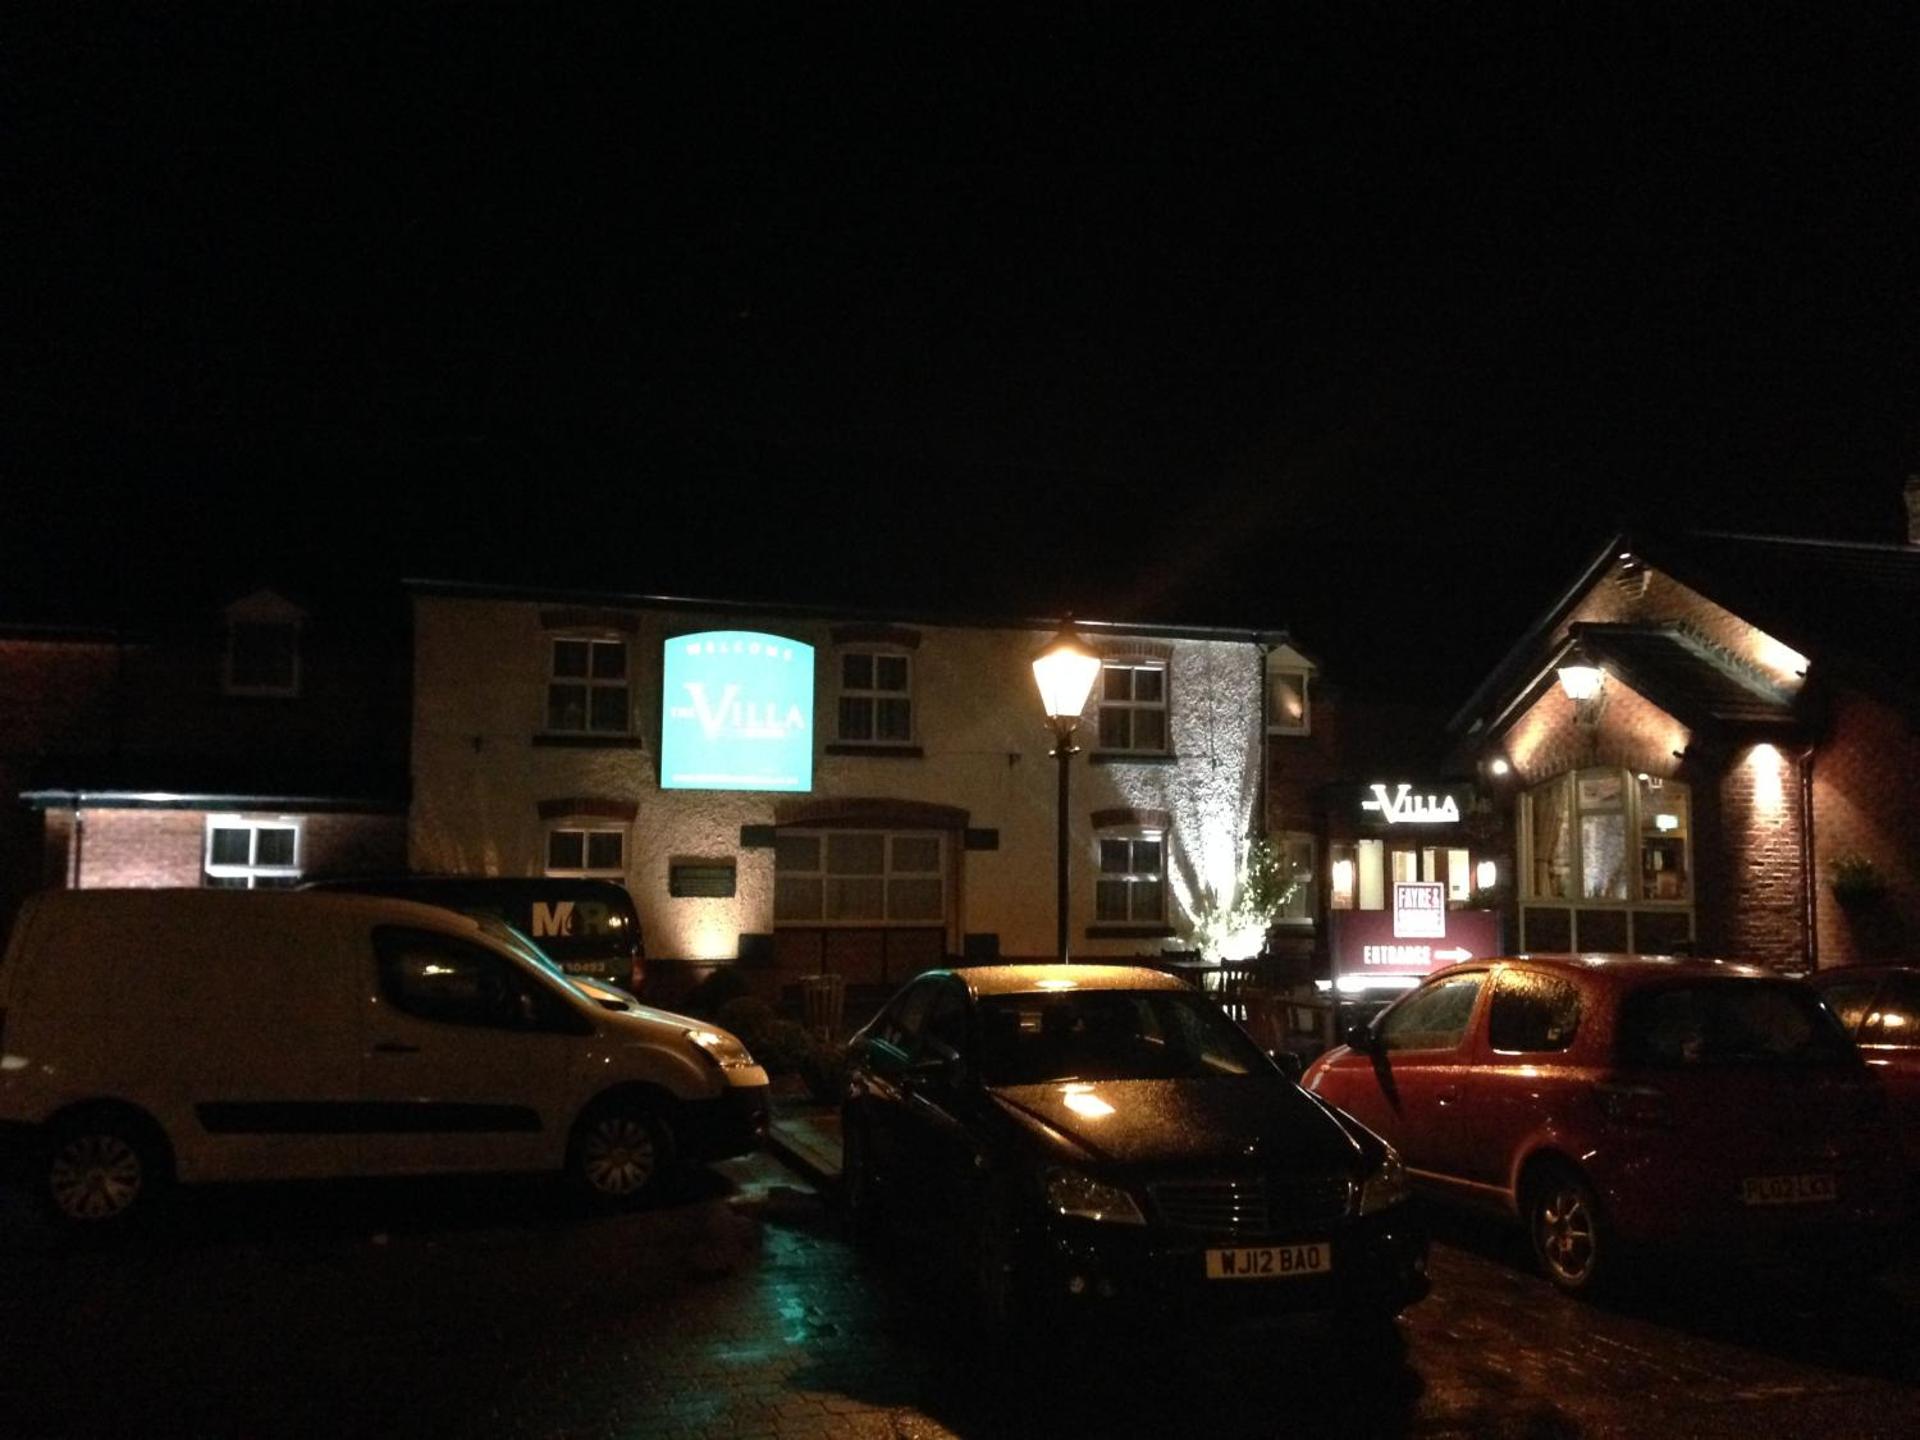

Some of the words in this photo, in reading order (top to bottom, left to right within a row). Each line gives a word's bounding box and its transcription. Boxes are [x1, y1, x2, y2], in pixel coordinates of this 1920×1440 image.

[683, 682, 806, 742] VILLA
[1370, 784, 1460, 824] VILLA
[1363, 945, 1432, 966] ENTRANCE
[1221, 1249, 1274, 1275] WJ12
[1279, 1245, 1322, 1272] BAO
